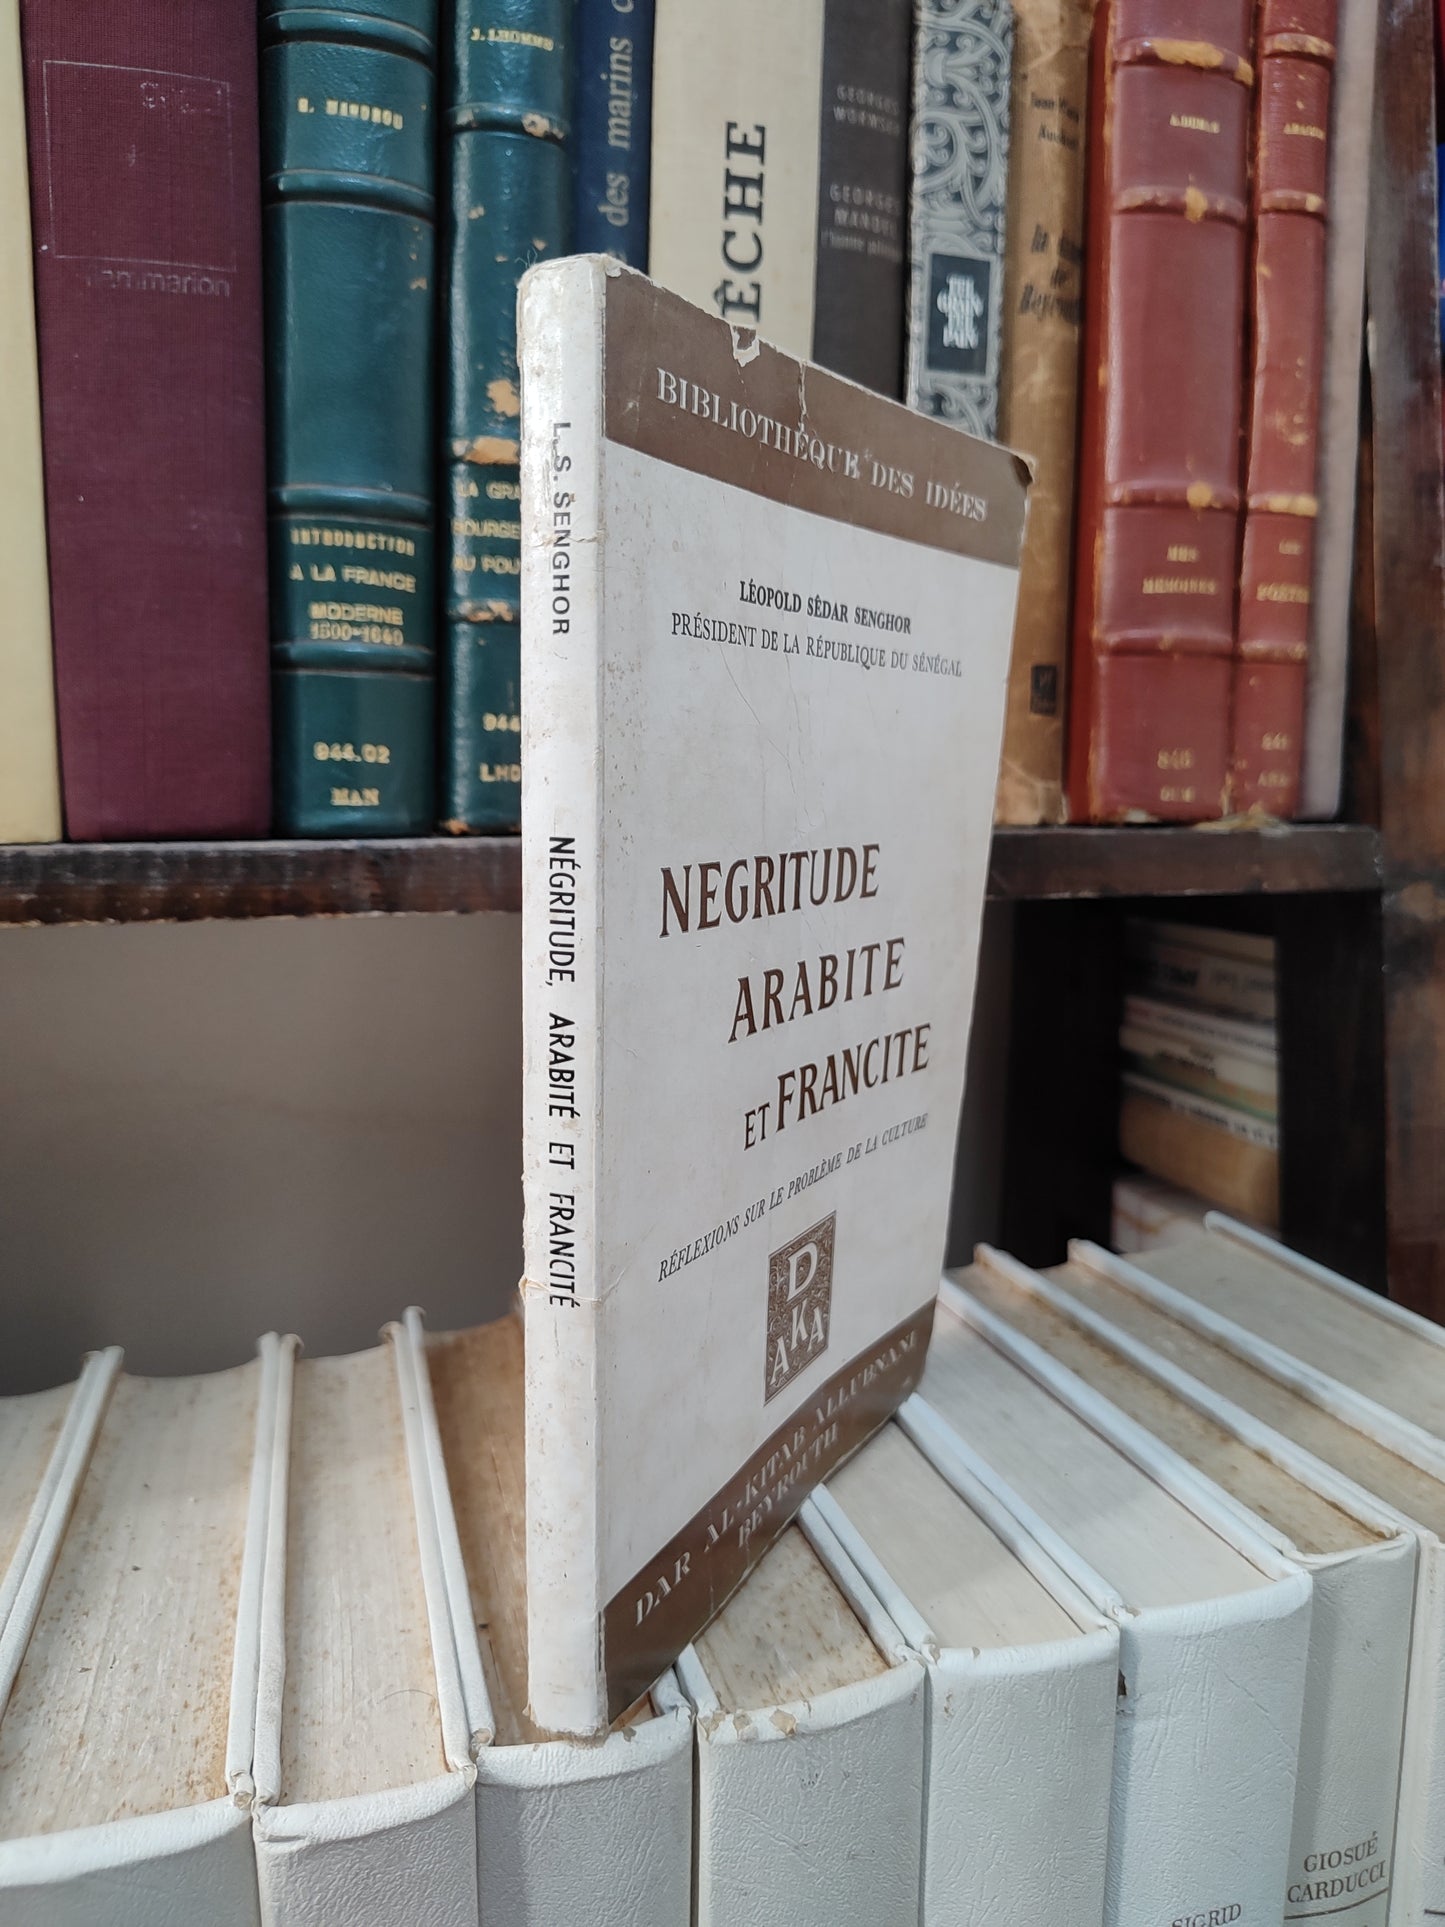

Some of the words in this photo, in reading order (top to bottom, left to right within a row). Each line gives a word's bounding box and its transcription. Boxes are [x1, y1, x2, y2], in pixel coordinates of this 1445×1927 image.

[600, 36, 634, 151] marins
[598, 171, 630, 227] des
[871, 461, 915, 499] DES
[926, 480, 987, 522] IDÉES
[290, 527, 416, 557] INTRODUCTION
[552, 491, 572, 635] SENGHOR
[308, 601, 404, 626] MODERNE
[309, 562, 337, 583] LA
[341, 564, 417, 594] FRANCE
[739, 578, 801, 613] LÉOPOLD
[853, 605, 911, 635] SENGHOR
[671, 611, 757, 648] PRÉSIDENT
[761, 628, 779, 652] DE
[783, 632, 800, 655] LA
[806, 634, 886, 670] RÉPUBLIQUE
[890, 650, 908, 671] DU
[911, 651, 963, 678] SÉNÉGAL
[544, 836, 582, 987] NÉGRITUDE,
[658, 843, 881, 939] NEGRITUDE
[727, 936, 906, 1044] ARABITE
[548, 1012, 581, 1119] ARABITÉ
[743, 1101, 771, 1151] ET
[775, 1022, 932, 1133] FRANCITE
[548, 1142, 575, 1171] ET
[657, 1215, 741, 1283] RÉFLEXIONS
[743, 1198, 767, 1228] SUR
[768, 1186, 785, 1211] LE
[786, 1151, 843, 1200] PROBLÈME
[846, 1142, 862, 1165] DE
[864, 1135, 878, 1155] LA
[881, 1112, 930, 1147] CULTURE
[548, 1191, 581, 1308] FRANCITÉ
[635, 1551, 691, 1627] DAR
[1287, 1860, 1386, 1904] CARDUCCI
[1303, 1831, 1379, 1873] GIOSUÉ
